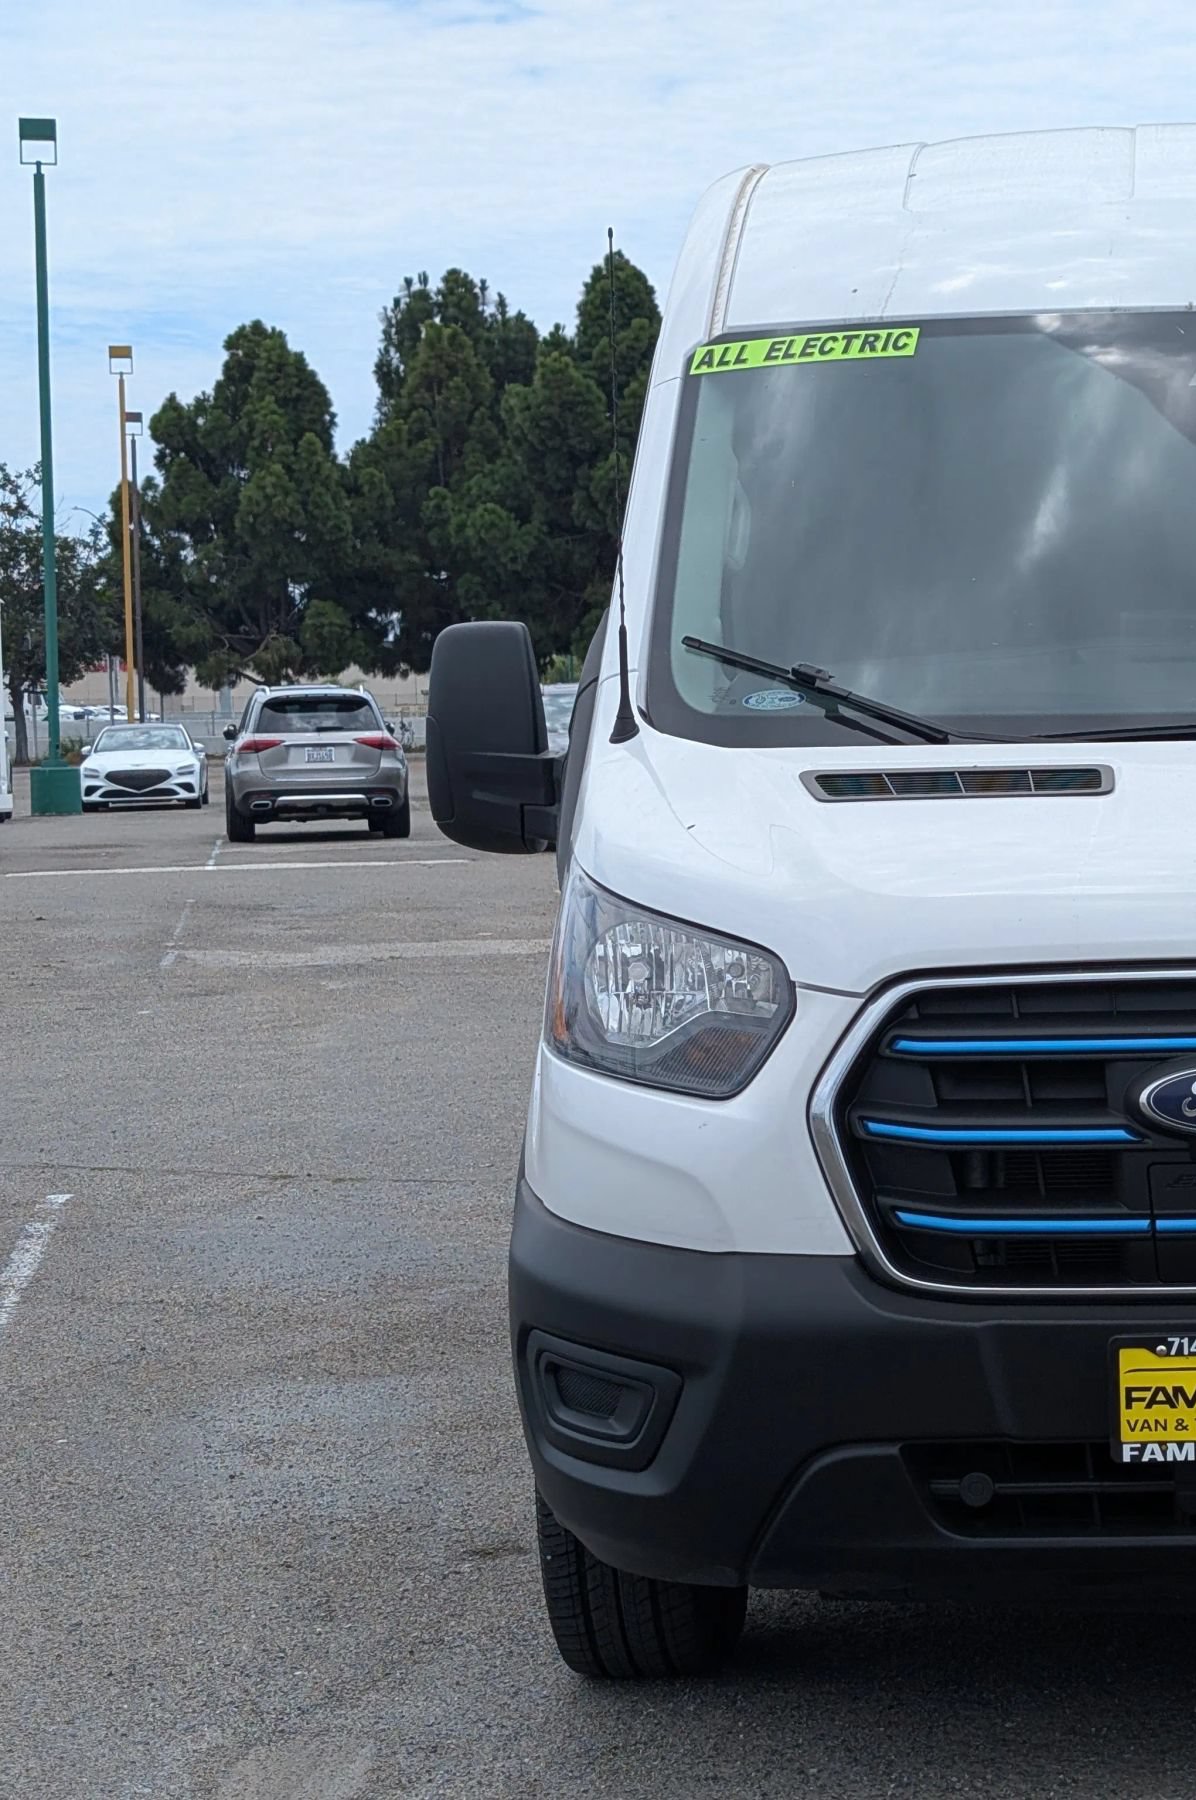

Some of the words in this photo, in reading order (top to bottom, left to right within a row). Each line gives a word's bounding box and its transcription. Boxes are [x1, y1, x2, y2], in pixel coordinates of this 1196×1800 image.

[694, 344, 749, 371] ALL
[763, 331, 915, 363] ELECTRIC
[1126, 1418, 1168, 1432] VAN
[1174, 1417, 1189, 1432] &
